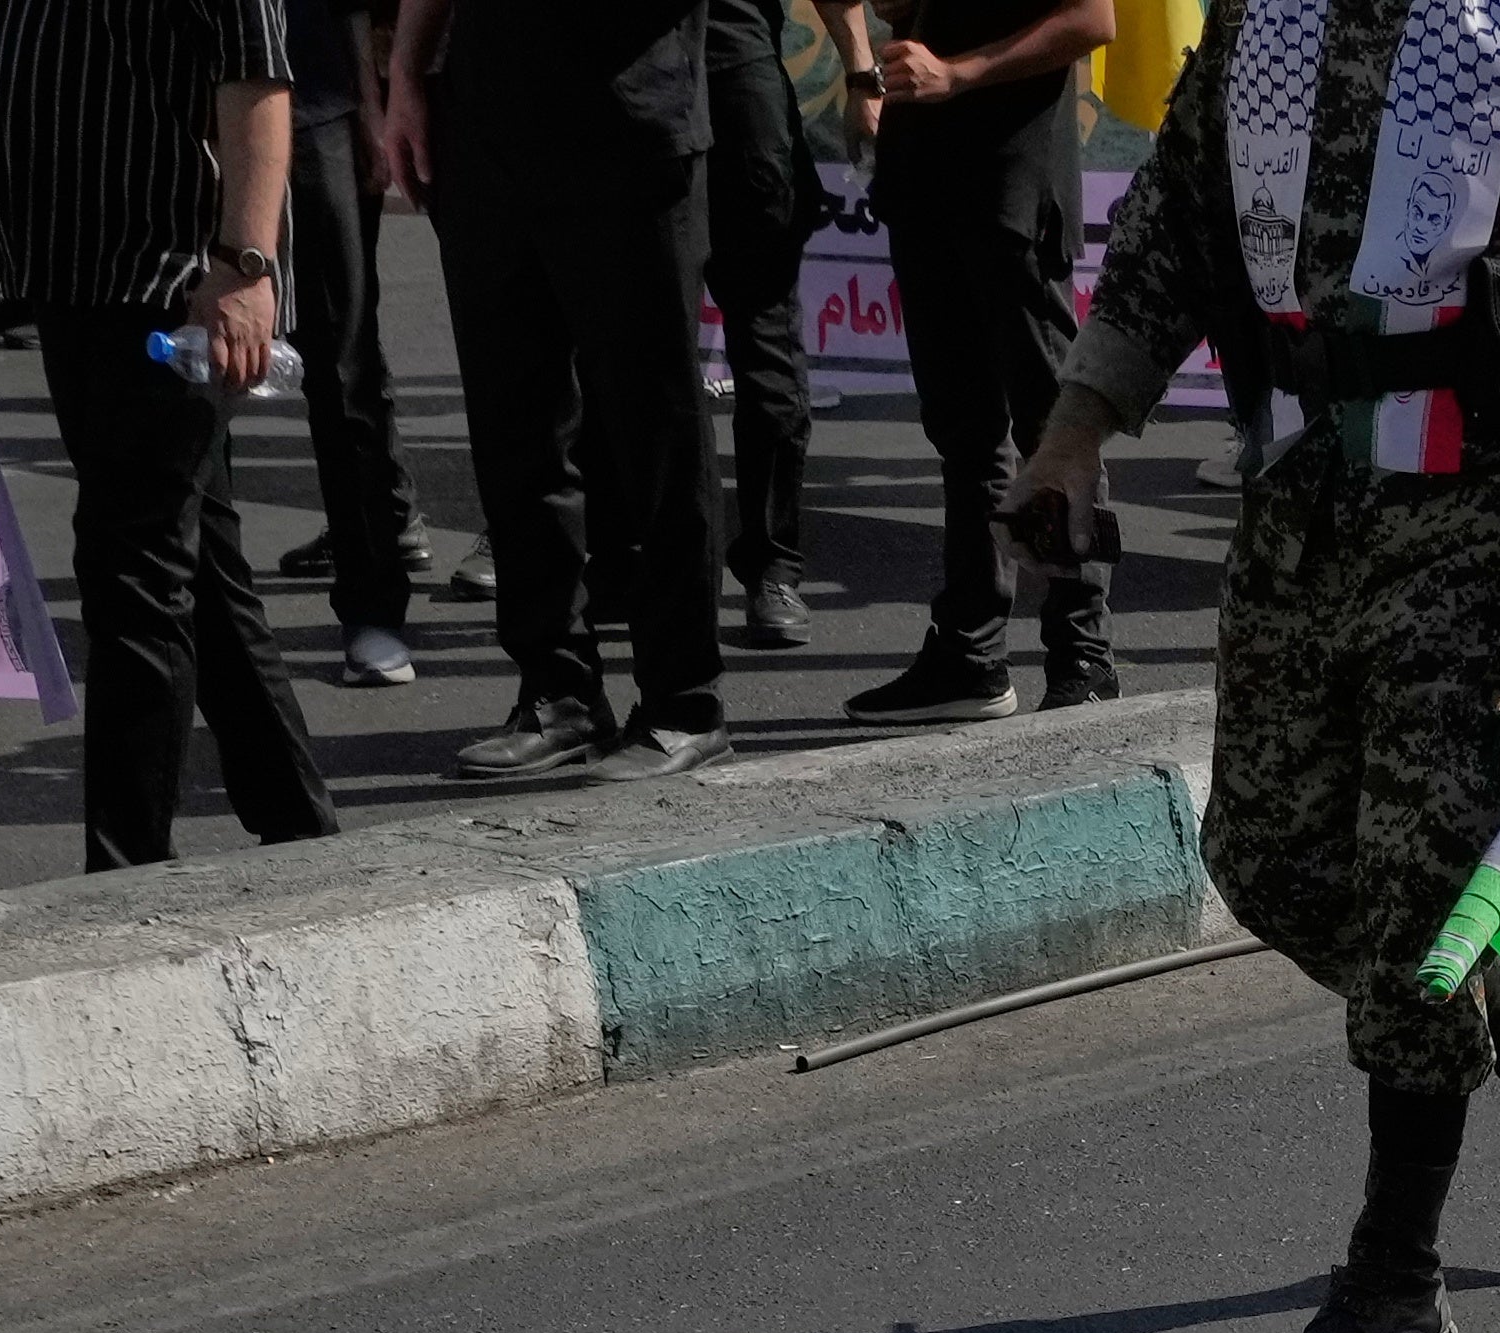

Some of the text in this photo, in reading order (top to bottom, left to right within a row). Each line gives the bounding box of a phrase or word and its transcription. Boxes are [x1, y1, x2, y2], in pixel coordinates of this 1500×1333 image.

[1235, 143, 1300, 176] القدس لنا
[1397, 128, 1491, 176] القدس لنا
[1363, 274, 1431, 298] قادمون
[818, 273, 901, 353] امام
